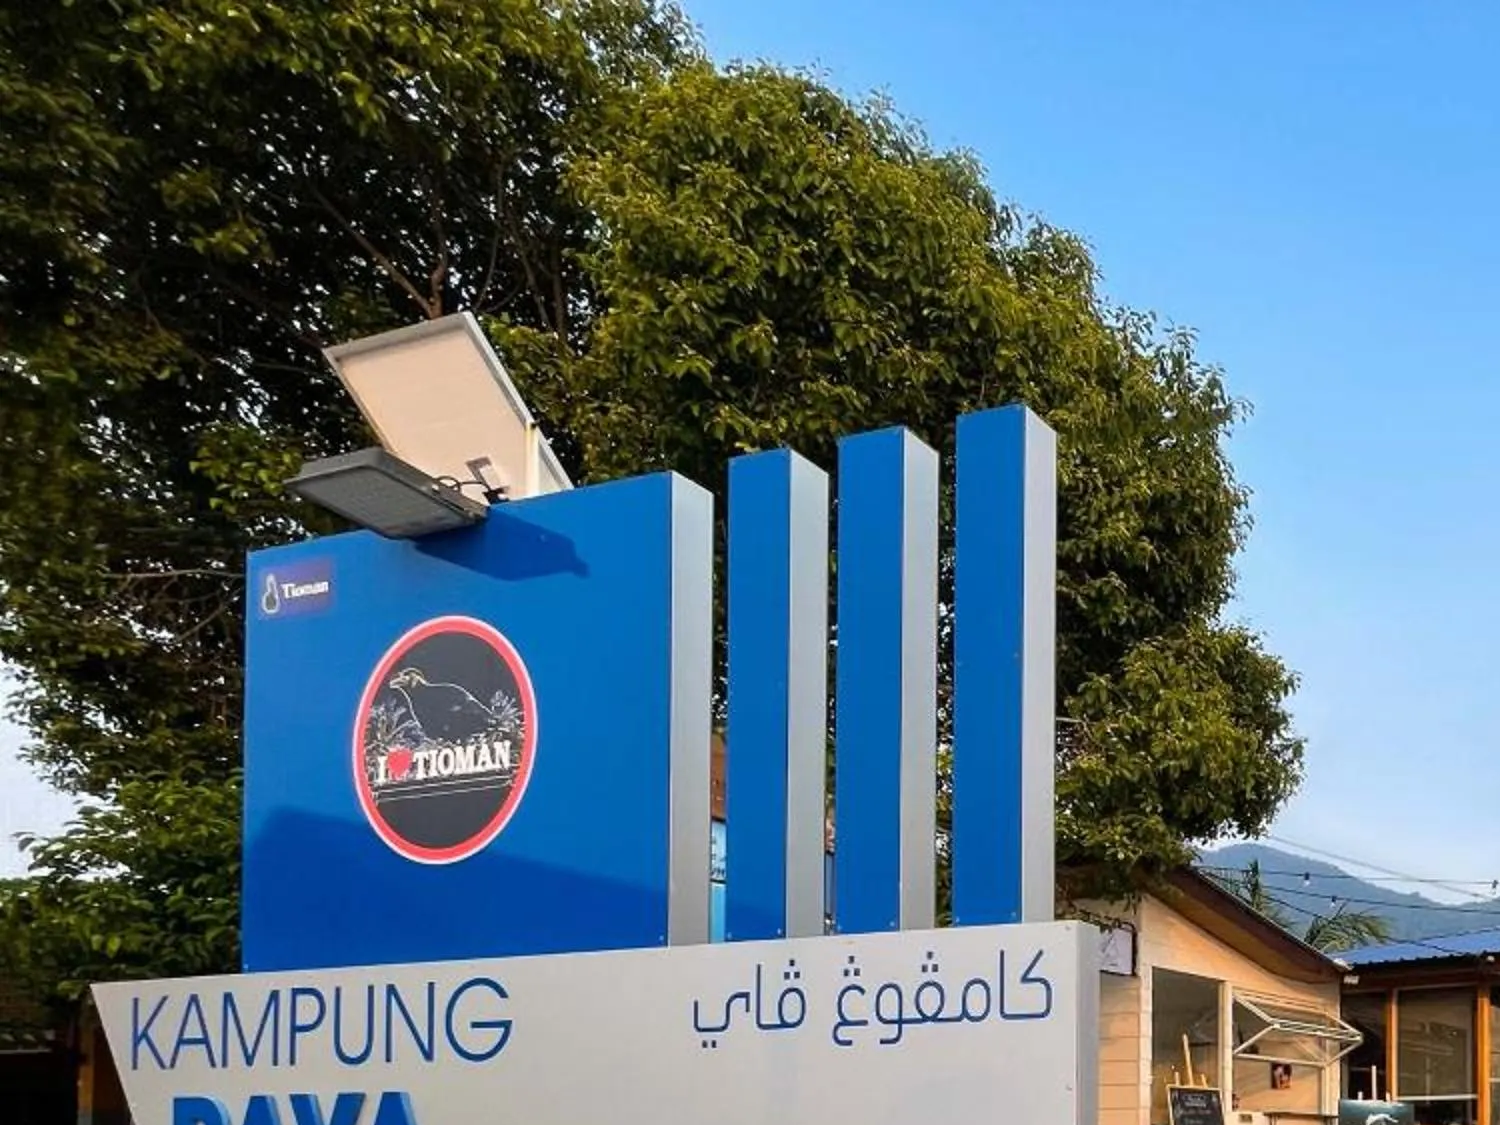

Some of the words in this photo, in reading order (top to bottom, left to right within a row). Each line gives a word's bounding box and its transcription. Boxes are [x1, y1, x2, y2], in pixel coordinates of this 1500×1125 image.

[280, 581, 329, 599] Tioman
[414, 741, 511, 780] TIOMAN
[131, 977, 513, 1071] KAMPUNG
